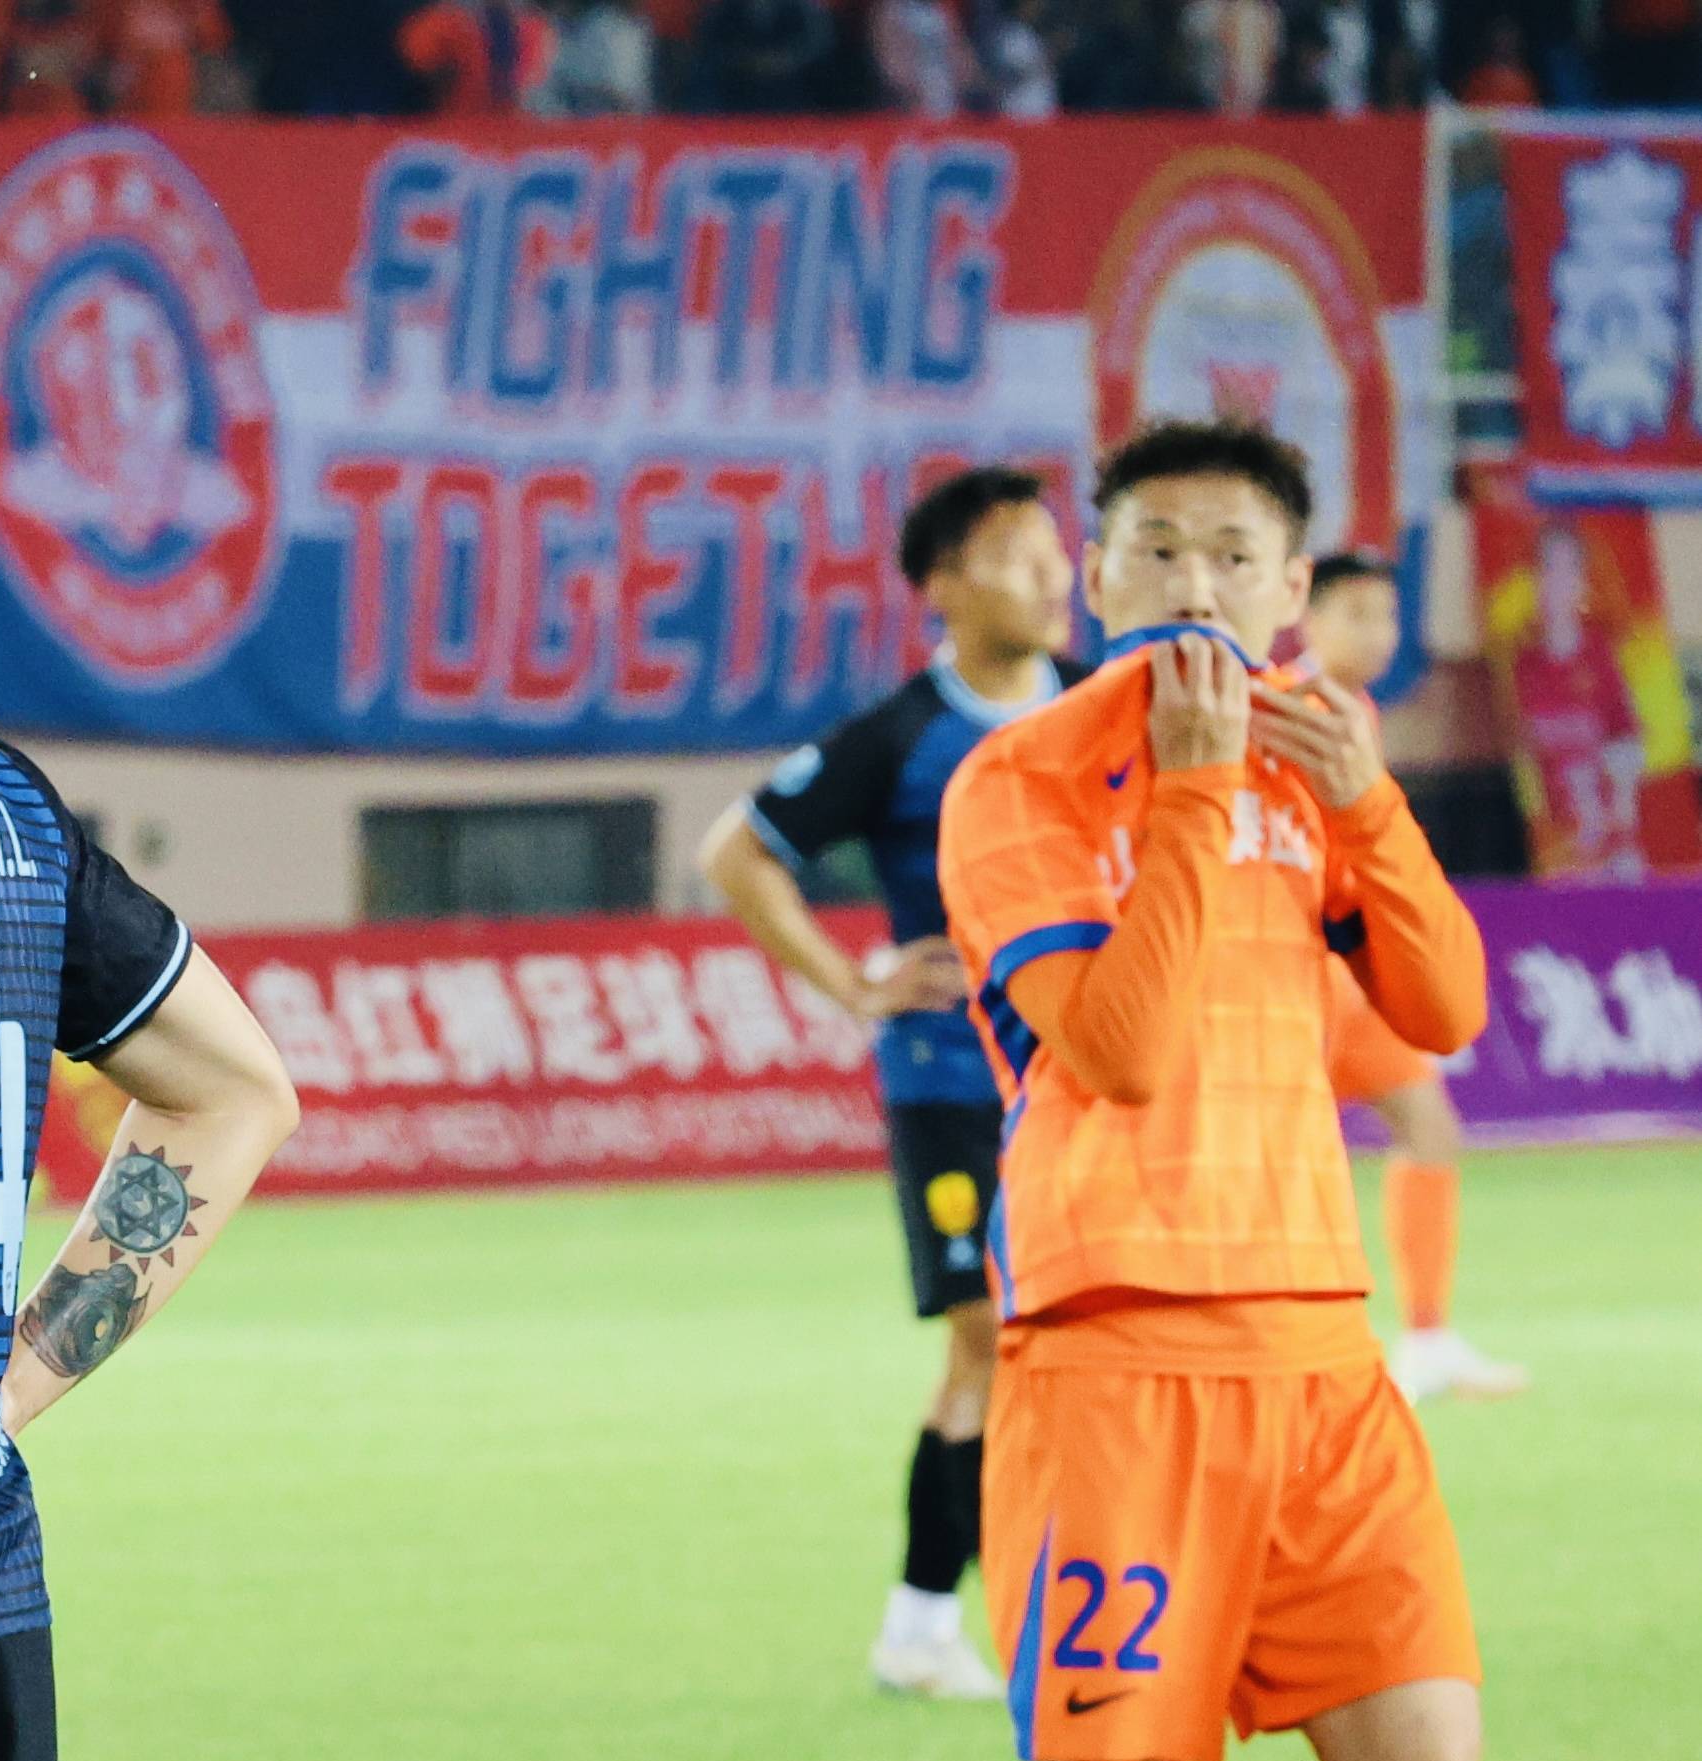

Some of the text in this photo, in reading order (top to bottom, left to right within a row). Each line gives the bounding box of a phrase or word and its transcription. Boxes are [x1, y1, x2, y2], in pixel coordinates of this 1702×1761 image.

[347, 138, 1015, 412] FIGHTING
[319, 454, 1085, 722] TOGETH
[1052, 1558, 1171, 1672] 22
